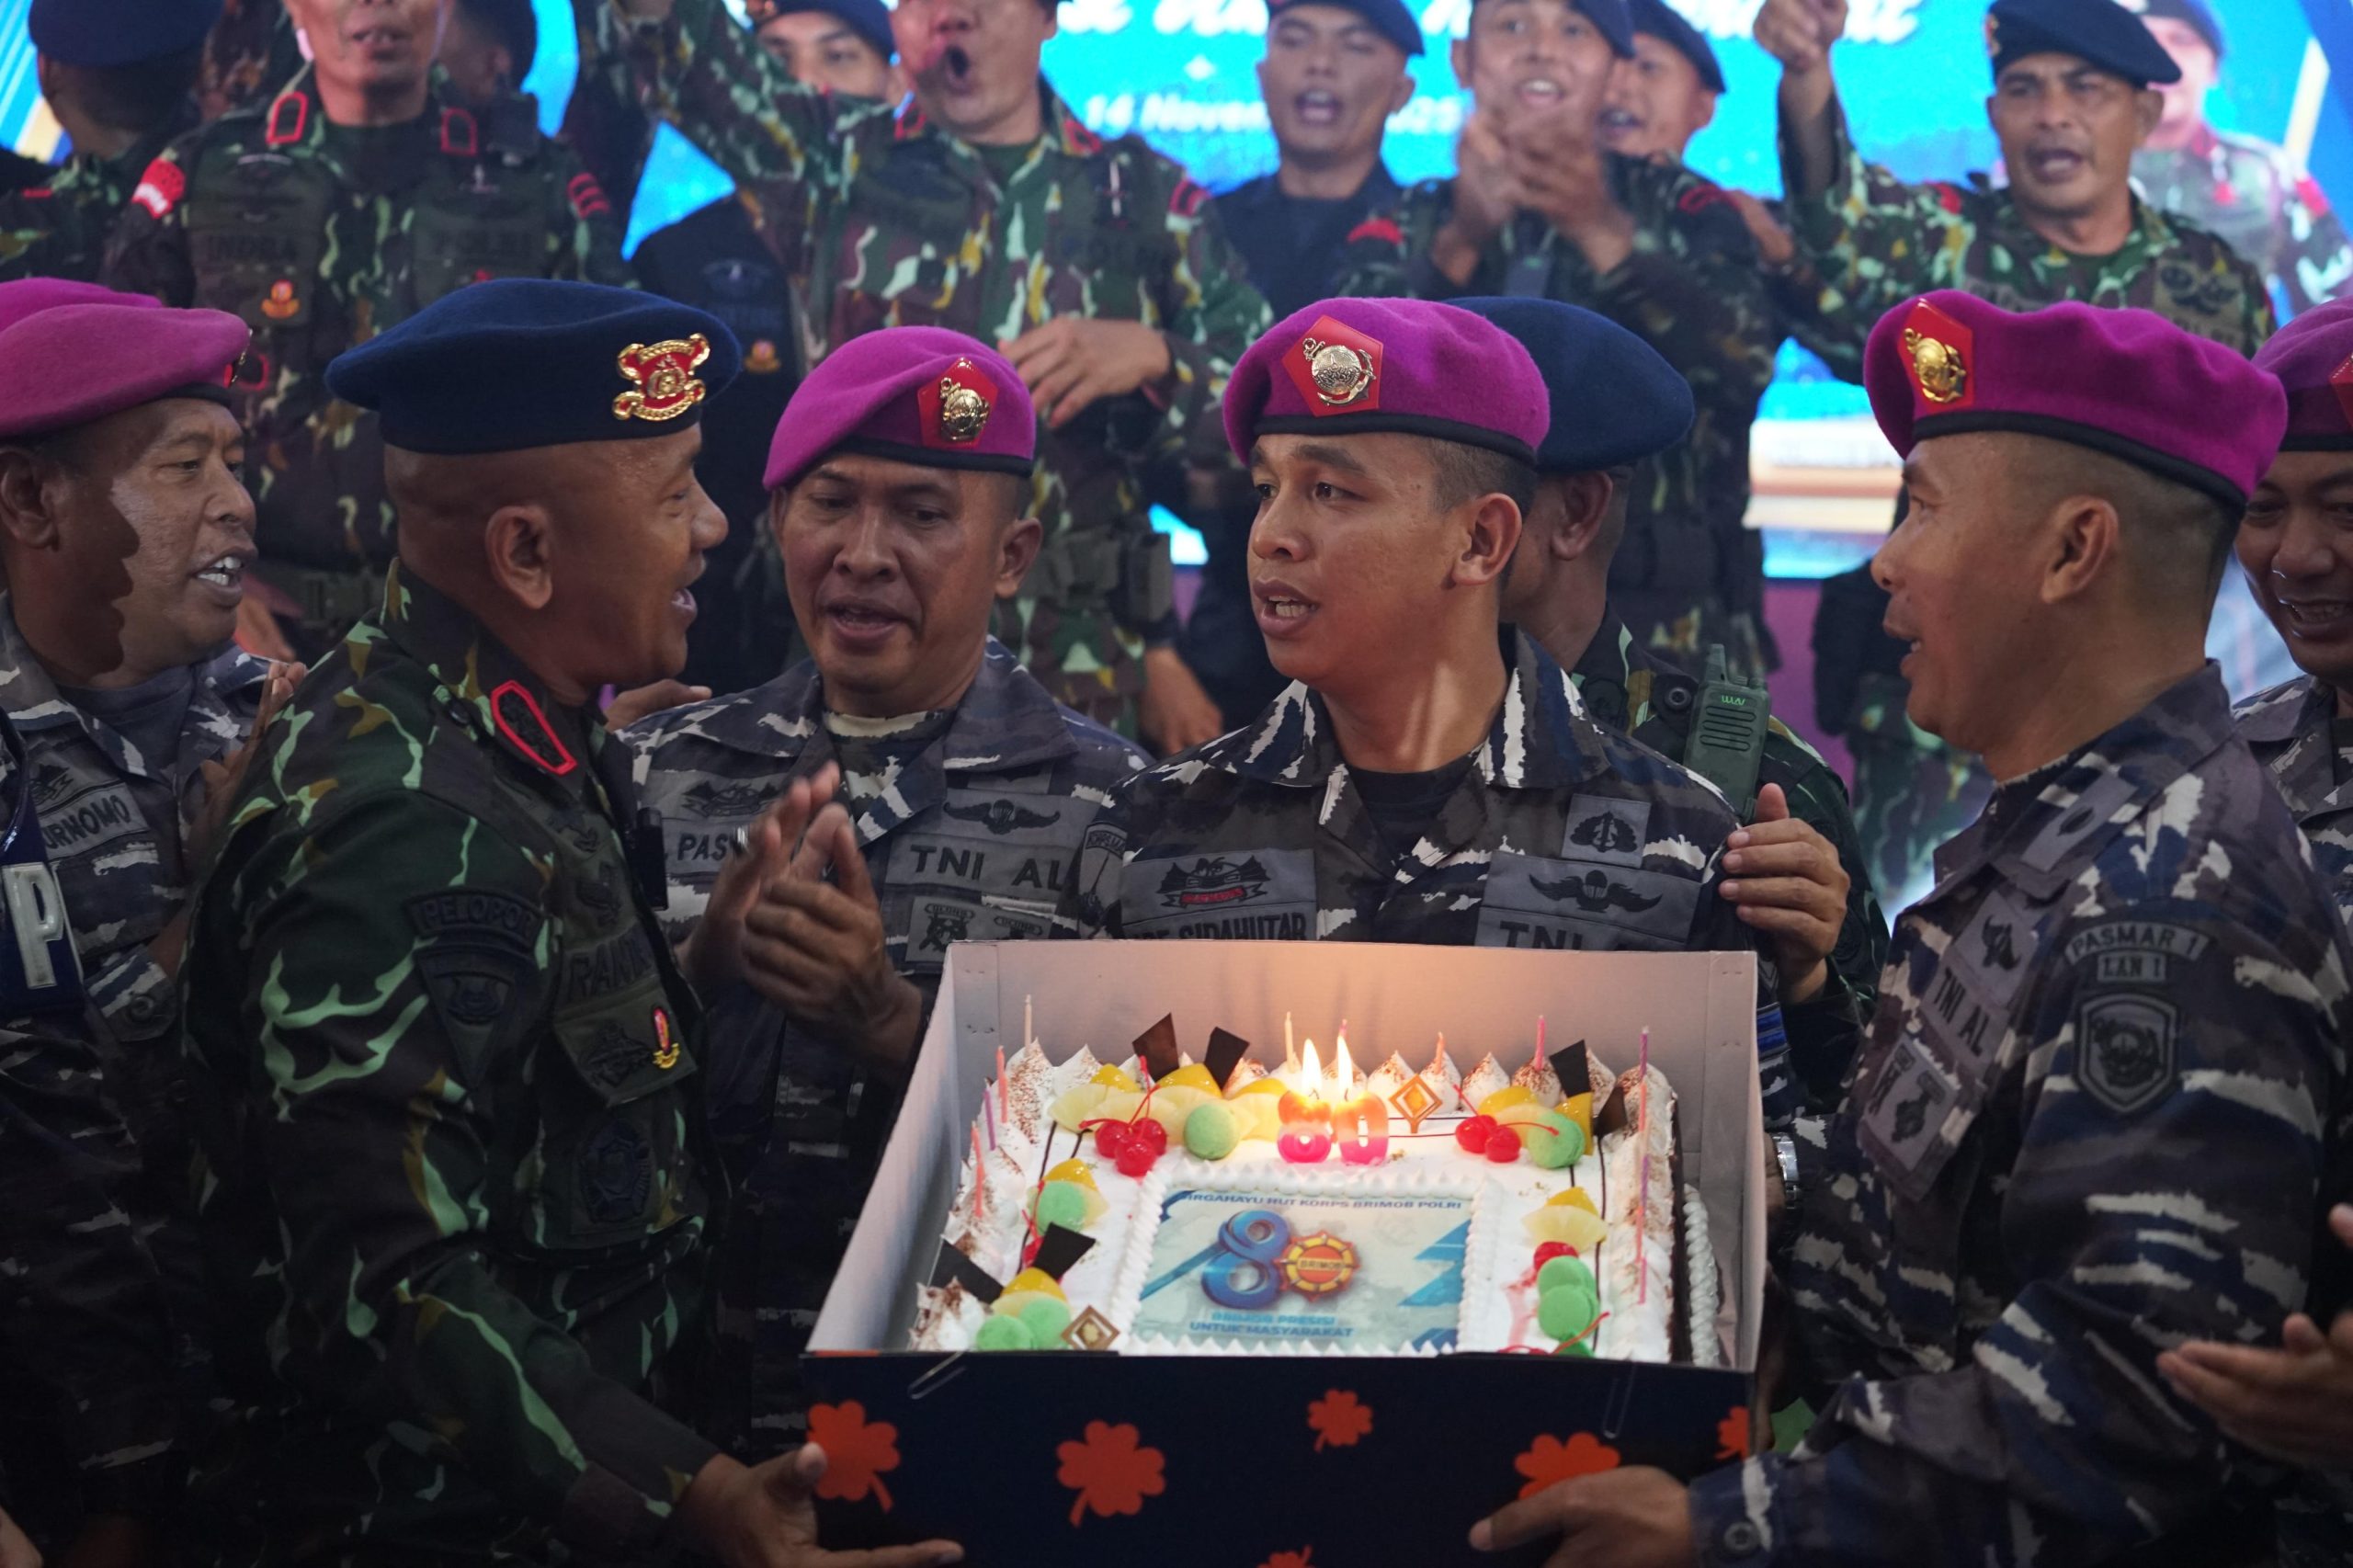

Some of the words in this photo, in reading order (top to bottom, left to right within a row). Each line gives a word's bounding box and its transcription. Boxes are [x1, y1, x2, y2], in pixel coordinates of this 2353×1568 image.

[45, 794, 131, 850] URNOMO
[677, 832, 735, 861] PAS
[911, 844, 984, 881] TNI
[1012, 858, 1064, 892] AL
[2, 861, 64, 990] P
[1499, 920, 1584, 951] TNI
[2072, 925, 2176, 958] PASMAR
[2186, 935, 2200, 957] 1
[1933, 966, 1966, 1024] TNI
[1956, 1004, 1991, 1057] AL
[1266, 1197, 1296, 1206] HUT
[1300, 1199, 1349, 1209] KORPS
[1353, 1199, 1415, 1210] BRIMOB
[1418, 1200, 1462, 1210] POLRI
[1189, 1322, 1242, 1333] UNTUK
[1245, 1325, 1354, 1337] MASYARAKAT
